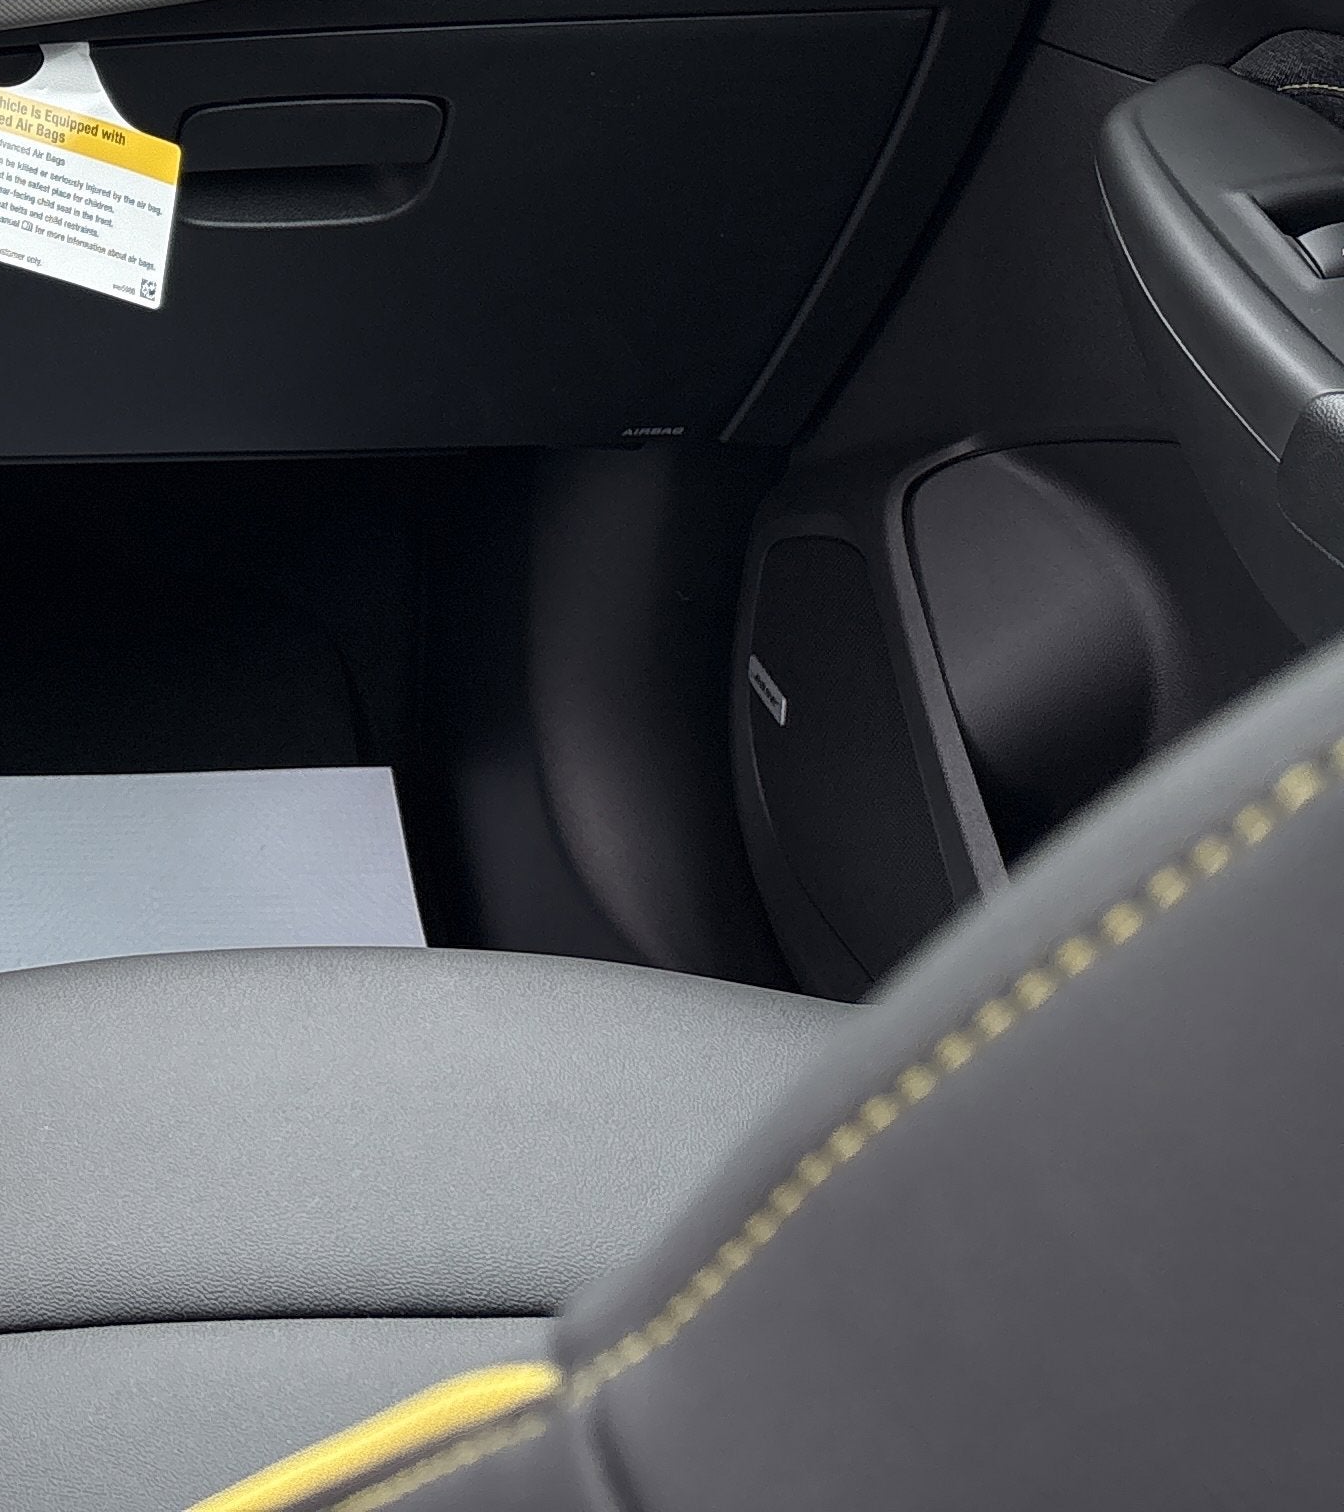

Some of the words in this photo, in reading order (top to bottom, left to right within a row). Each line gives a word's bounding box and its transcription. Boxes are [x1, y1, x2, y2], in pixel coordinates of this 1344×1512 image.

[15, 117, 34, 133] Air
[36, 123, 66, 144] Bags
[44, 109, 100, 137] Equipped
[101, 127, 126, 146] with
[32, 148, 44, 160] Air
[45, 152, 66, 167] Bags
[5, 157, 16, 168] be
[17, 161, 39, 175] killed
[39, 170, 49, 178] or
[49, 172, 84, 190] seriously
[85, 181, 112, 199] injured
[112, 190, 122, 203] by
[123, 195, 136, 206] the
[136, 200, 147, 210] air
[5, 172, 13, 182] is
[14, 175, 27, 186] the
[27, 180, 51, 193] safest
[51, 187, 72, 200] place
[72, 192, 84, 203] for
[9, 203, 28, 215] belts
[29, 210, 44, 221] and
[44, 214, 63, 226] child
[37, 197, 56, 209] child
[56, 204, 72, 215] seat
[73, 208, 81, 217] in
[82, 210, 94, 221] the
[34, 224, 46, 235] for
[46, 229, 66, 242] more
[66, 234, 107, 255] information
[107, 248, 127, 262] about
[128, 254, 138, 264] air
[621, 426, 685, 437] AIRBAG
